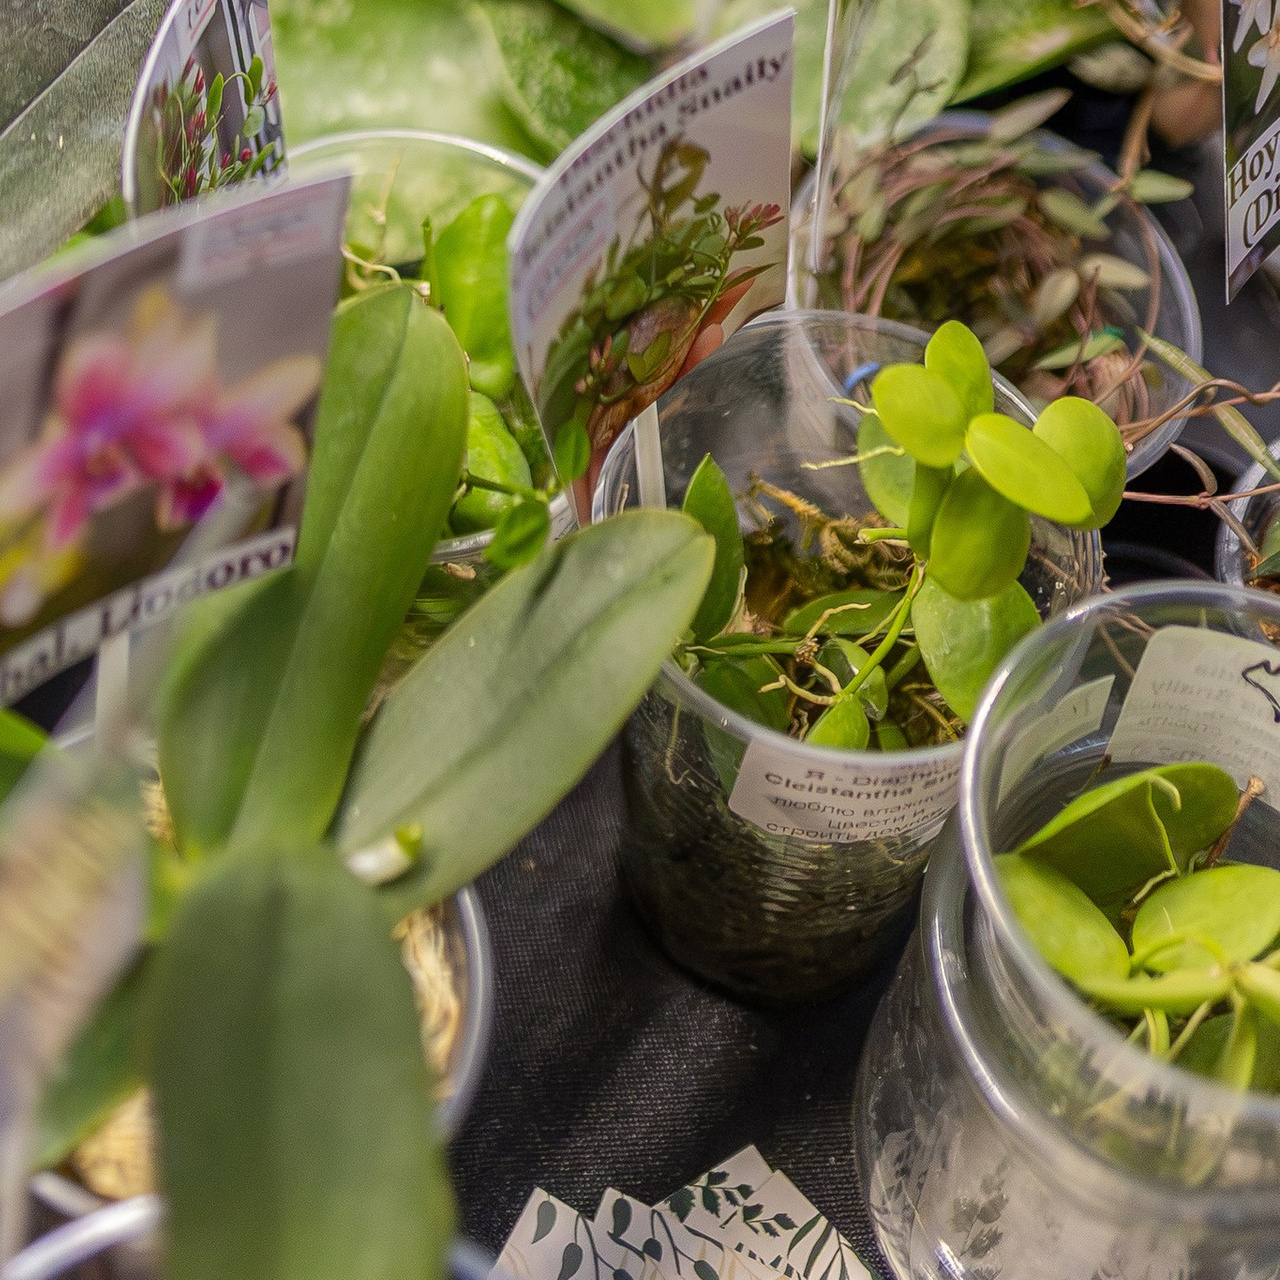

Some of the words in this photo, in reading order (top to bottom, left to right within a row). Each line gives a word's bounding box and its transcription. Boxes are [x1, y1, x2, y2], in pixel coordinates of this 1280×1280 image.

[764, 772, 913, 800] Cleistantha
[770, 796, 855, 817] люблю
[765, 822, 859, 841] строить
[827, 814, 906, 830] цвести
